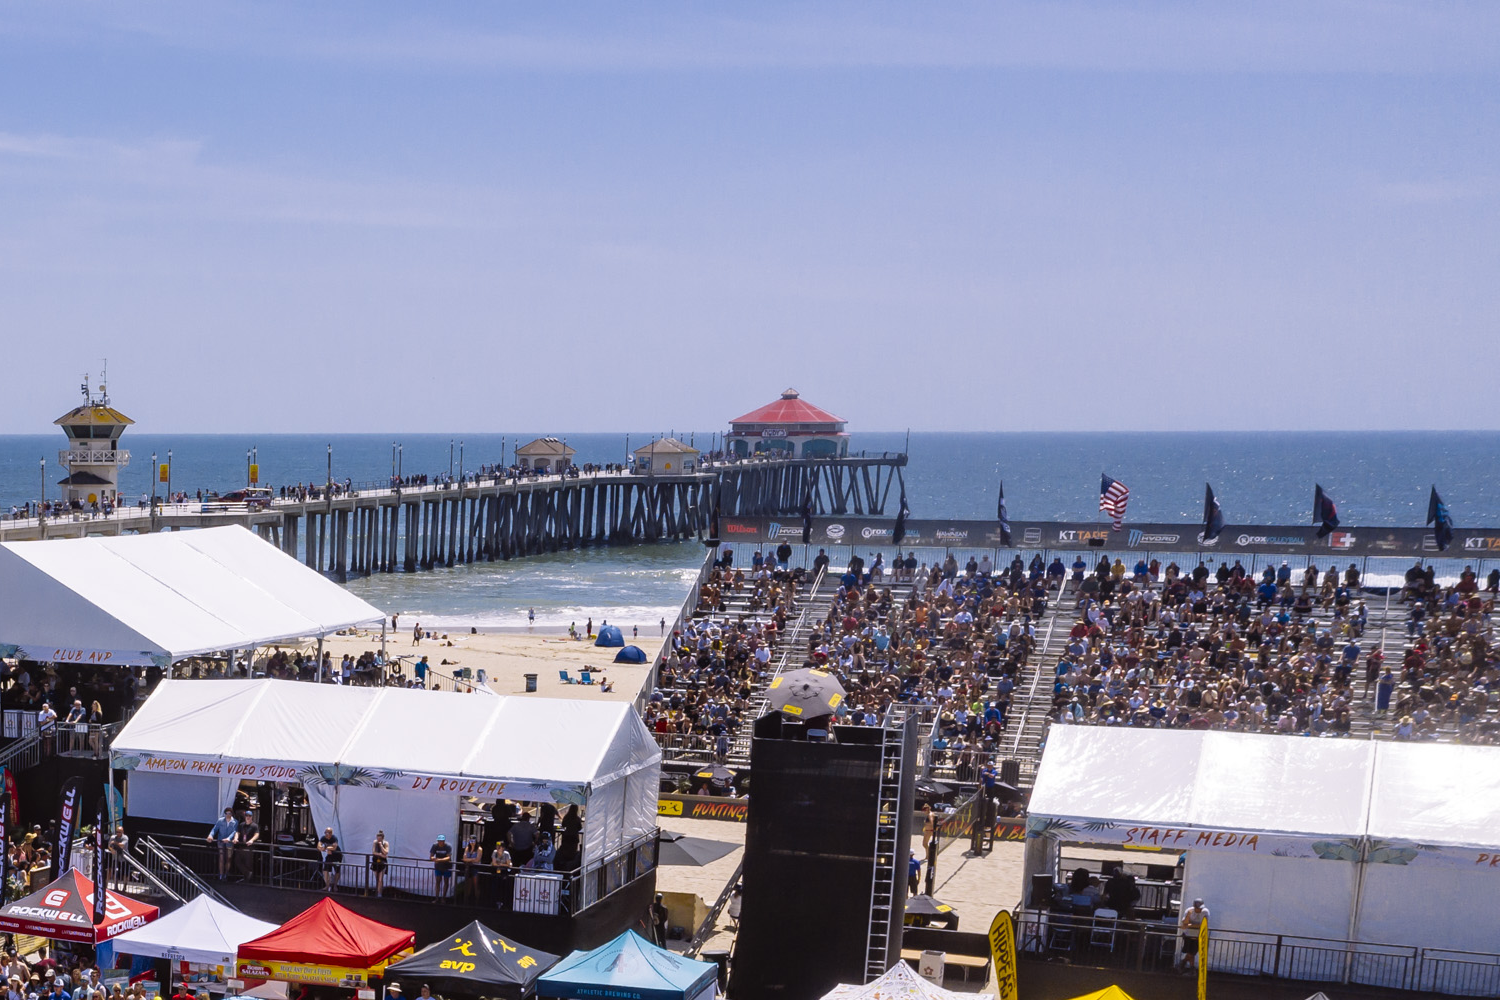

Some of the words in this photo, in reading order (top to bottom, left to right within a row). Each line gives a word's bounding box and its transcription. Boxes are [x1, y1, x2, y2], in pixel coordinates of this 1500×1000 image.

[727, 524, 757, 534] Wilson
[1059, 530, 1076, 541] KT
[1465, 537, 1485, 548] KT
[53, 649, 83, 661] CLUB
[89, 651, 113, 663] AVP
[145, 757, 188, 772] AMAZON
[191, 760, 225, 774] PRIME
[226, 763, 256, 776] VIDEO
[258, 766, 296, 779] STUDIO
[411, 776, 431, 791] DJ
[1123, 827, 1185, 845] STAFF
[1194, 832, 1260, 851] MEDIA
[8, 906, 86, 924] ROCKWELL
[107, 915, 147, 937] ROCKWELL
[439, 959, 475, 973] avp
[992, 922, 1013, 1000] HIPPEAS
[577, 988, 603, 997] ATHLETIC
[605, 990, 628, 999] BREWING
